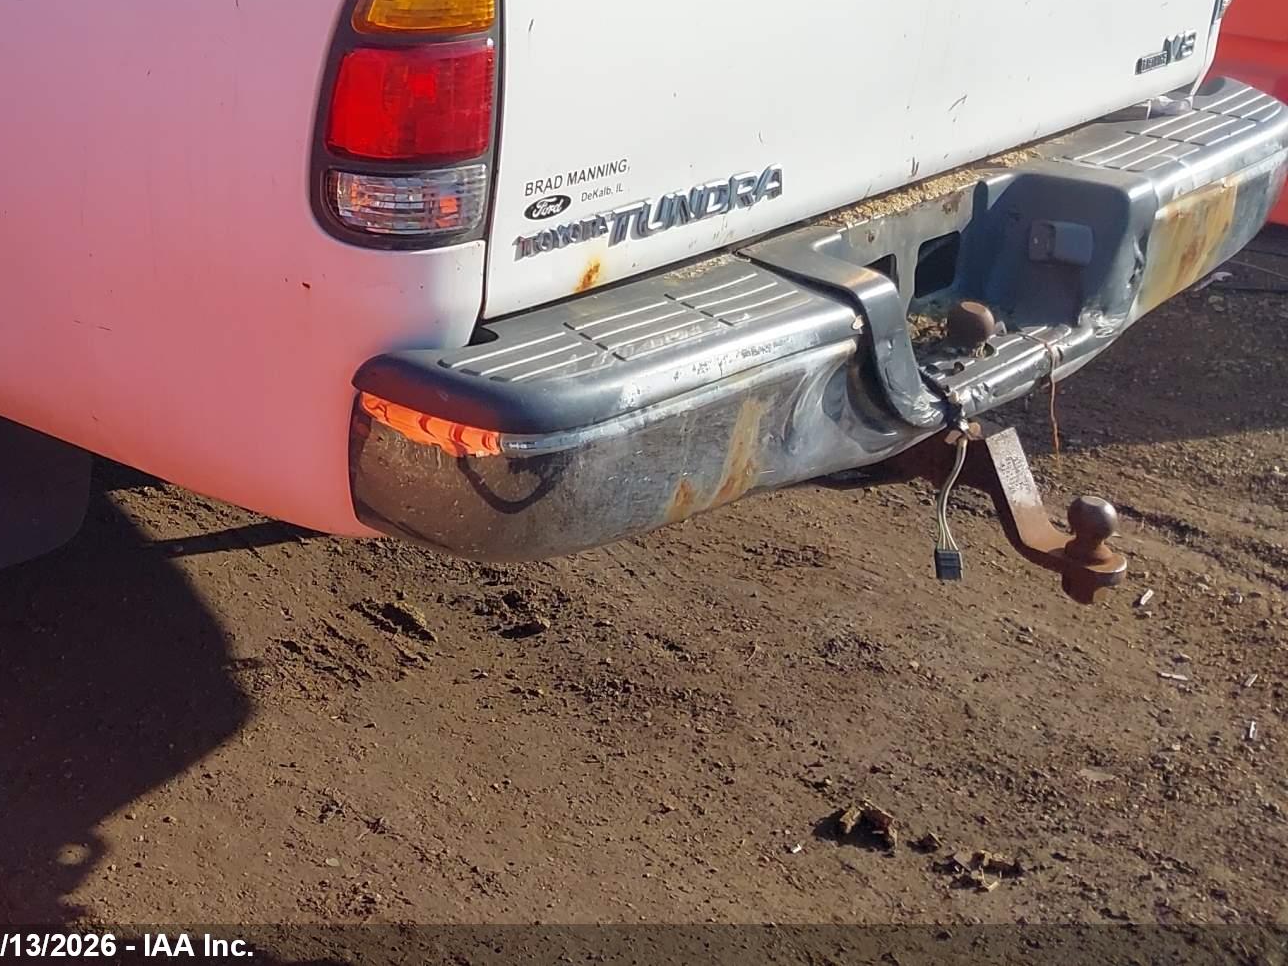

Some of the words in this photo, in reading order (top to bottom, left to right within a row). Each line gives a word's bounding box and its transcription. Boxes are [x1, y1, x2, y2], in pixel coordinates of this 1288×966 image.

[524, 174, 564, 197] BRAD
[512, 213, 609, 262] TOYOTA
[607, 163, 784, 248] TUNDRA
[530, 196, 566, 219] Ford
